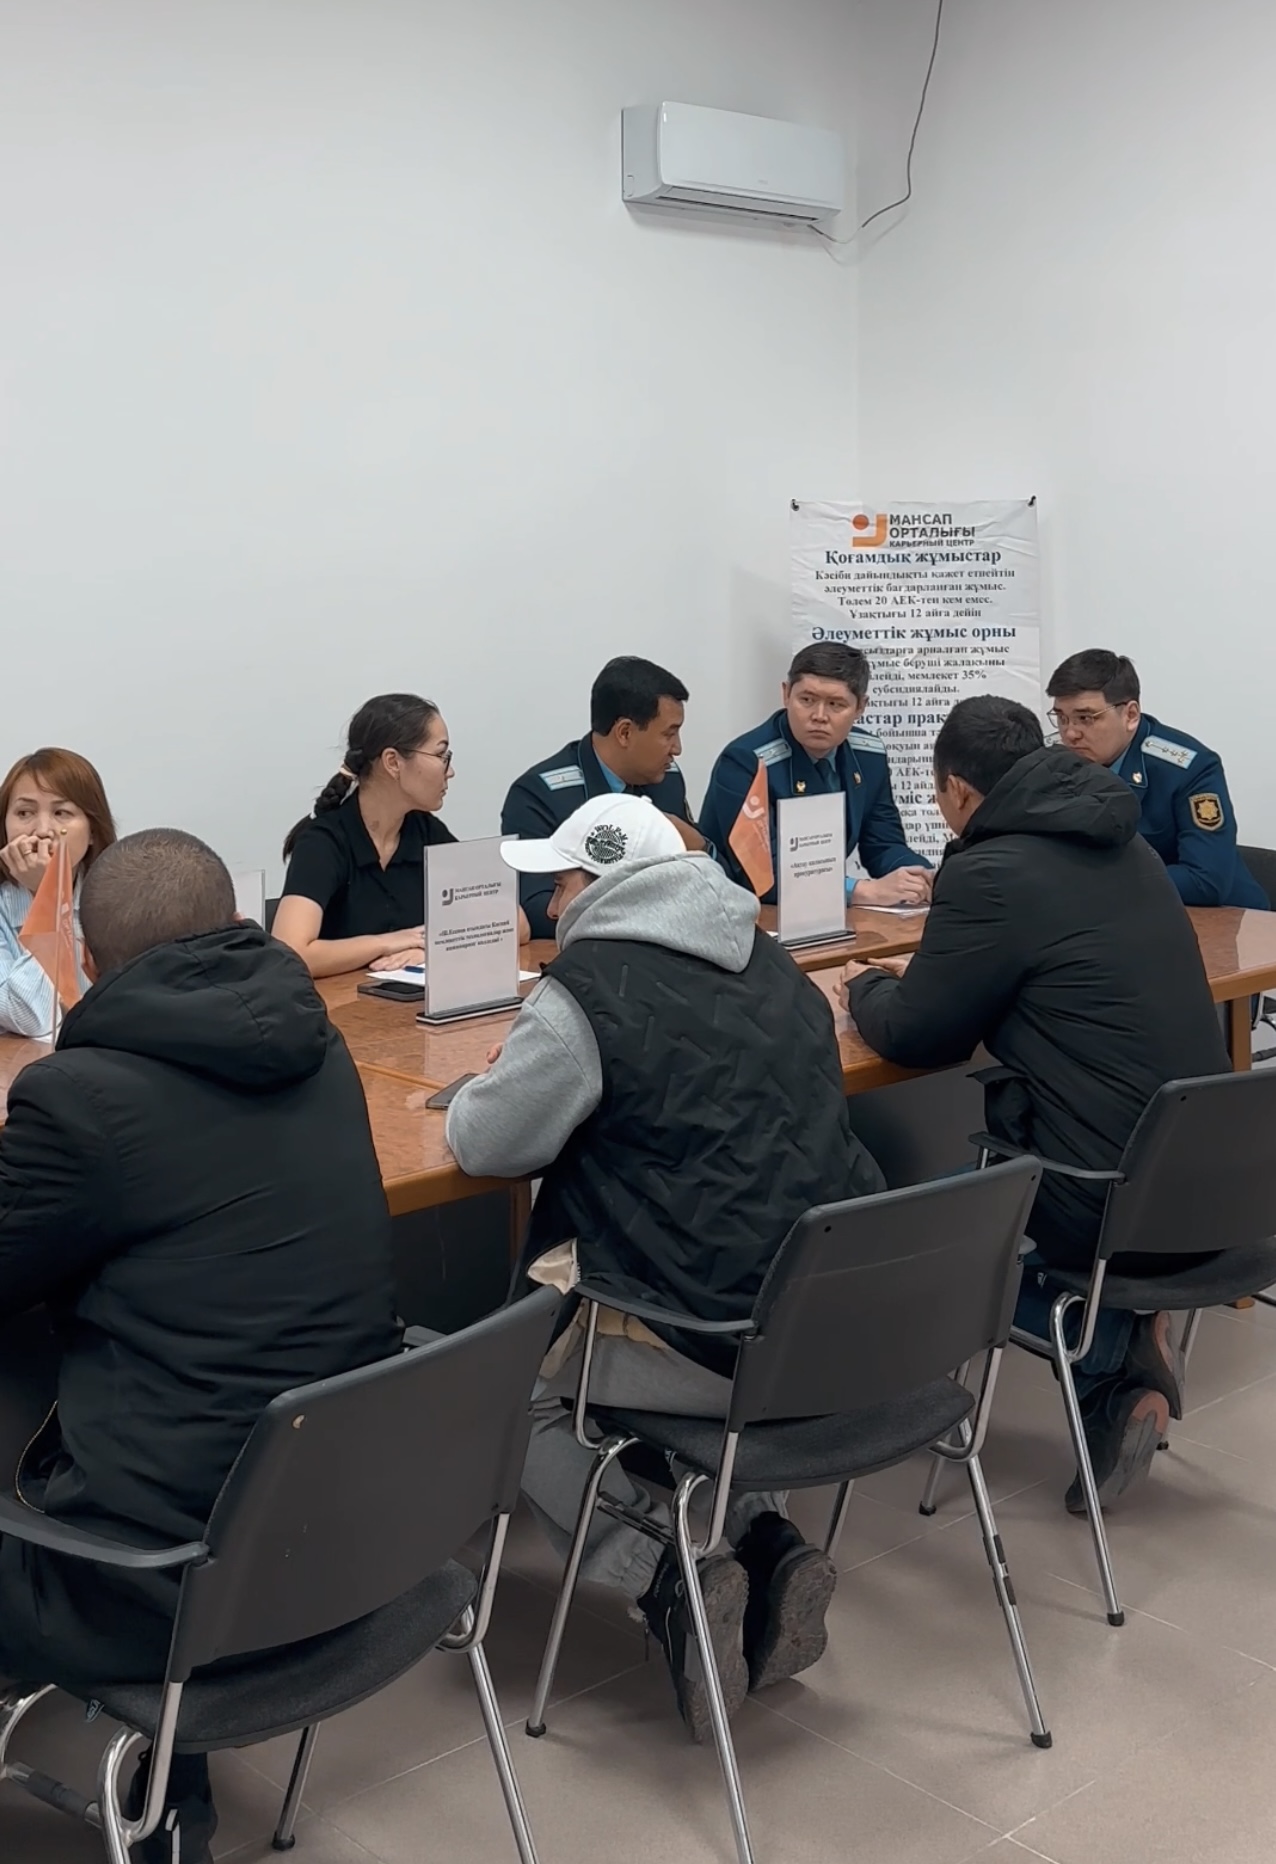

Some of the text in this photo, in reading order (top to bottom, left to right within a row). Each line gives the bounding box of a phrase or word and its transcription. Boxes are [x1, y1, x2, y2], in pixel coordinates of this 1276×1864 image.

[889, 513, 952, 526] МАНСАП
[889, 526, 976, 539] ОРТАЛЫҒЫ
[889, 539, 975, 549] КАРЬЕРНЫЙ ЦЕНТР
[825, 550, 1002, 566] Қоғамдық жұмыстар
[874, 596, 888, 605] 20
[910, 608, 922, 618] 12
[971, 626, 1016, 642] орны
[962, 669, 988, 680] 35%
[911, 697, 923, 707] 12
